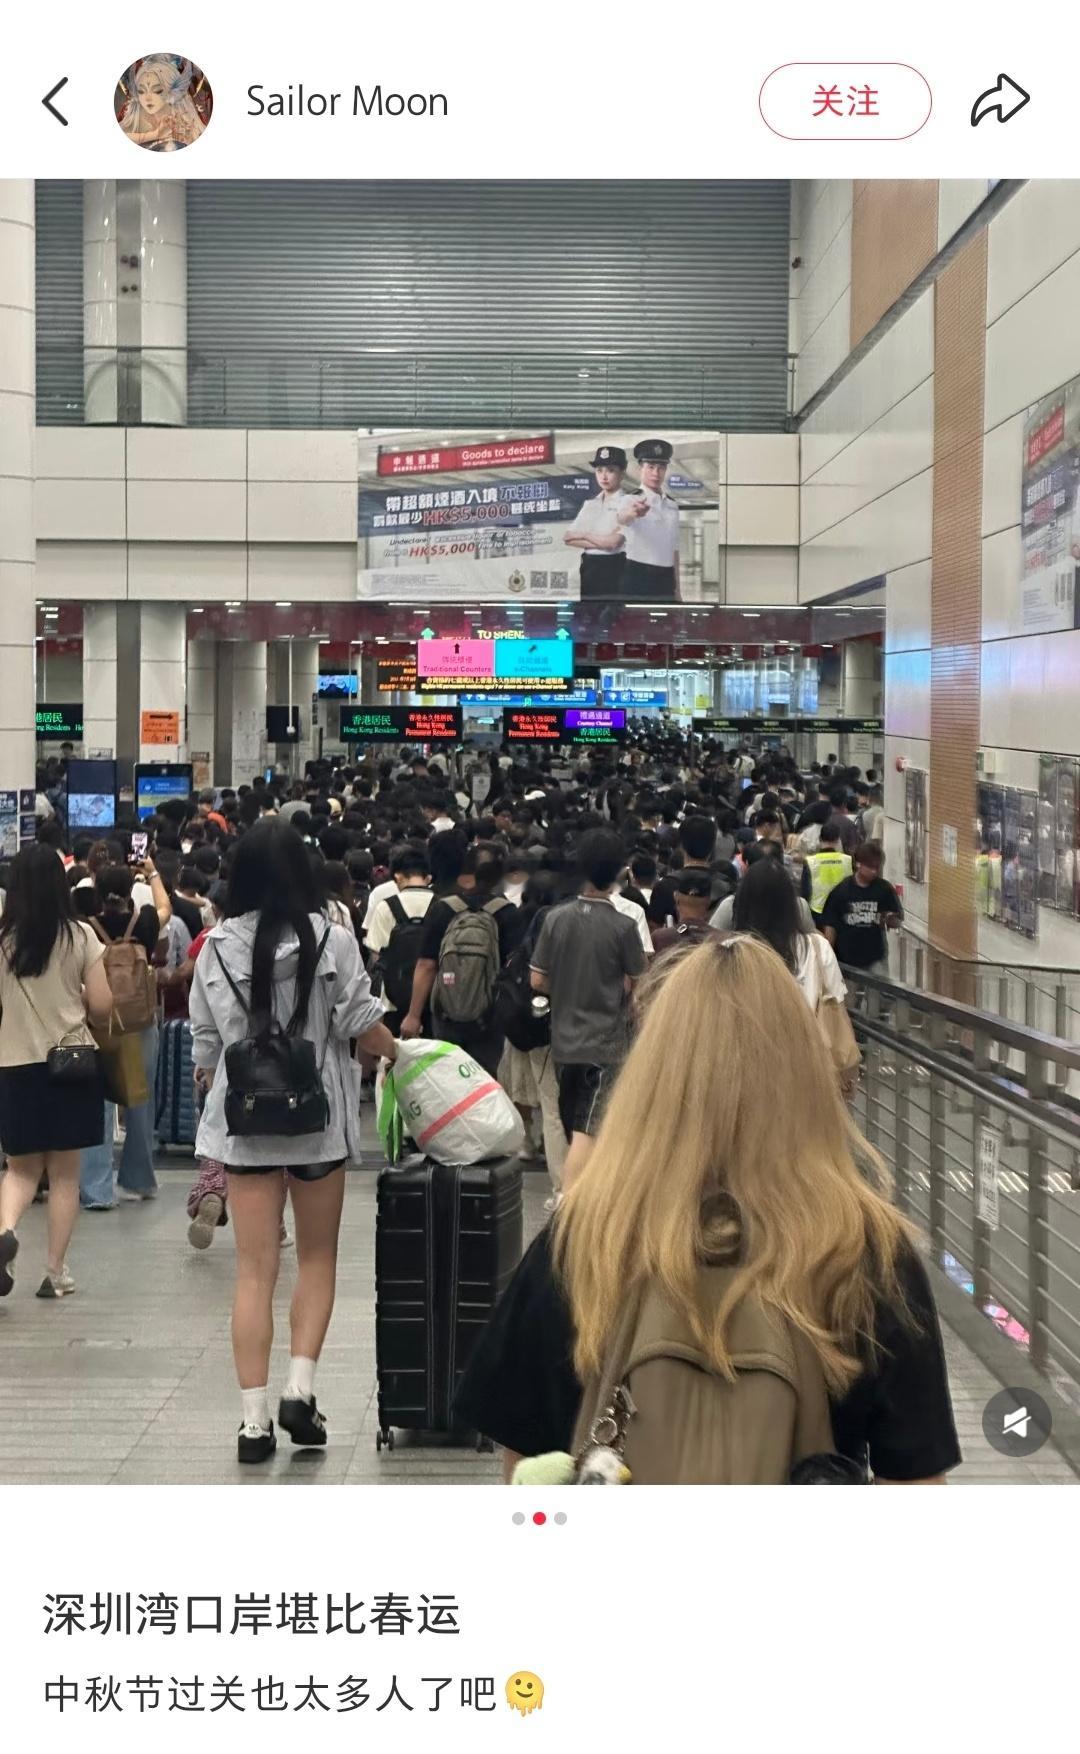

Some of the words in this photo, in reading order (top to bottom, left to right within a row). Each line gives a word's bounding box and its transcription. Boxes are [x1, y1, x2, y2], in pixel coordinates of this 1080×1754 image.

[462, 449, 492, 461] Goods
[494, 448, 505, 457] to
[507, 444, 545, 456] declare
[409, 542, 476, 558] HK$5,000
[493, 630, 525, 639] SHEN
[423, 665, 459, 673] Traditional
[460, 665, 492, 673] Counters
[352, 714, 392, 726] 香港居民
[343, 726, 358, 734] Hong
[359, 726, 373, 734] Kong
[374, 726, 399, 734] Residents
